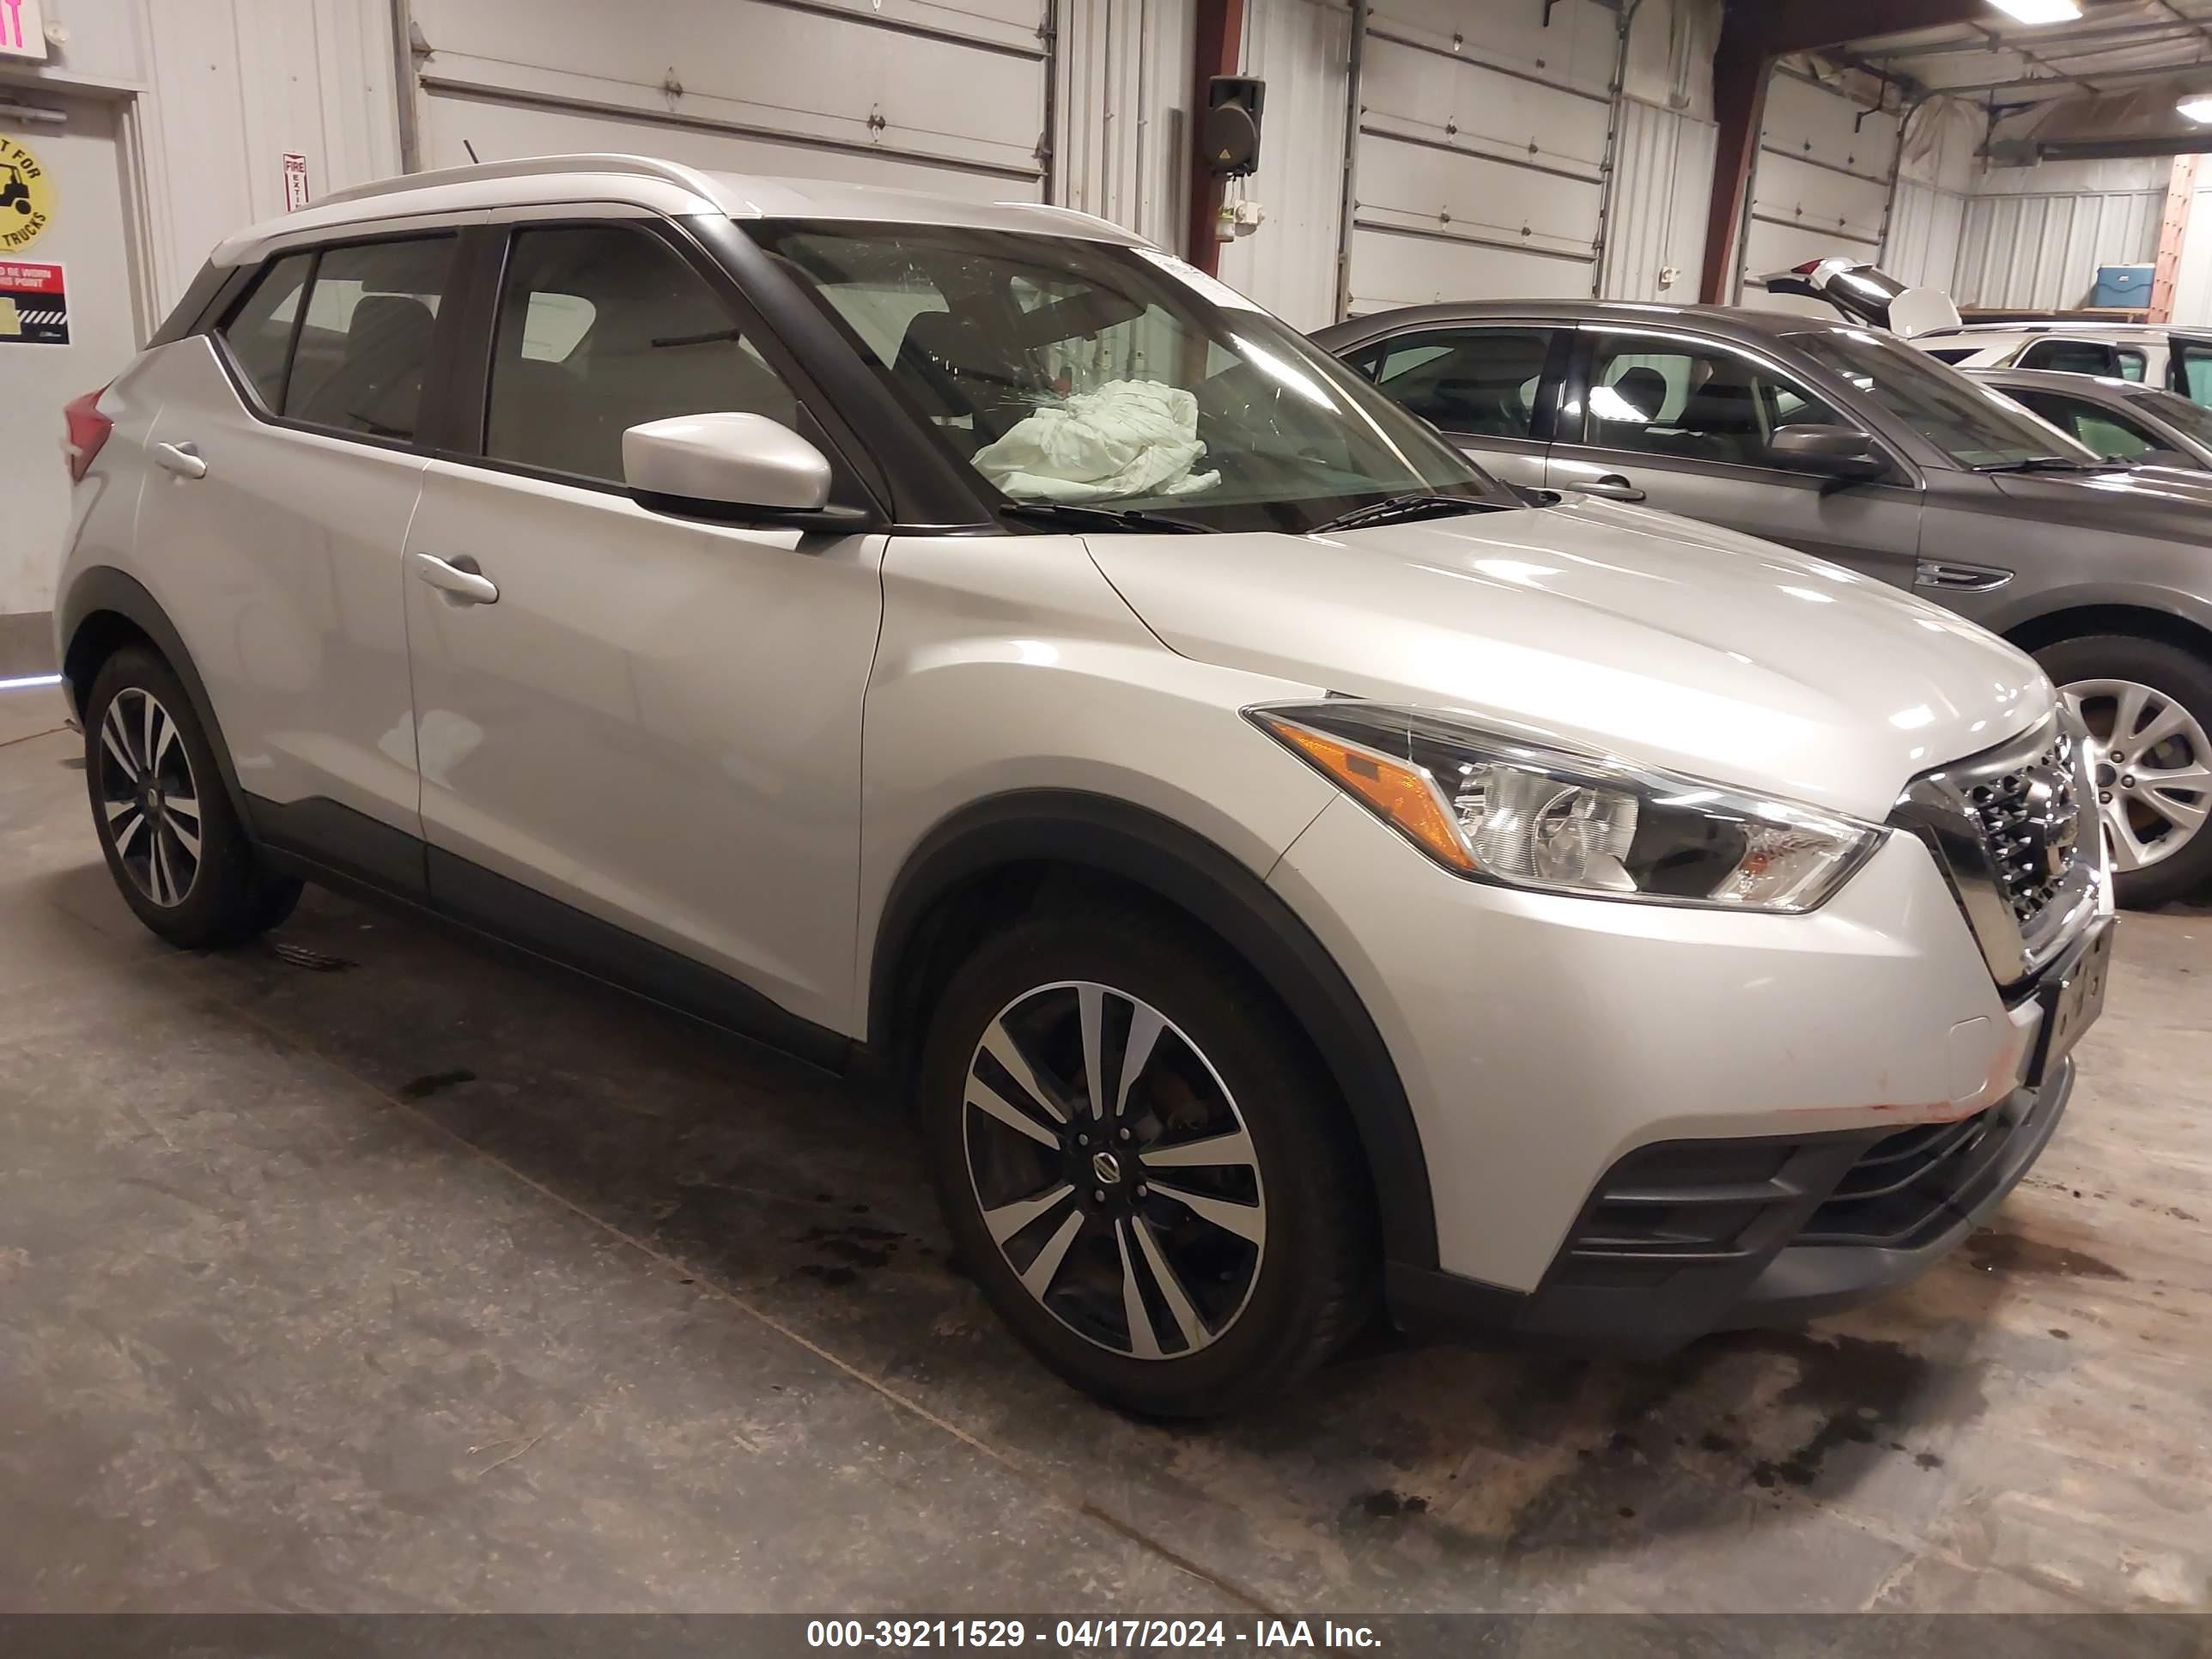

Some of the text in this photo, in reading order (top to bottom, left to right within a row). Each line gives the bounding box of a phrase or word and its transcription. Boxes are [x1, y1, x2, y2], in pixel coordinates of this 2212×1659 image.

[12, 149, 41, 179] FOR
[286, 161, 304, 173] FIRE
[2, 211, 46, 246] TRUCKS
